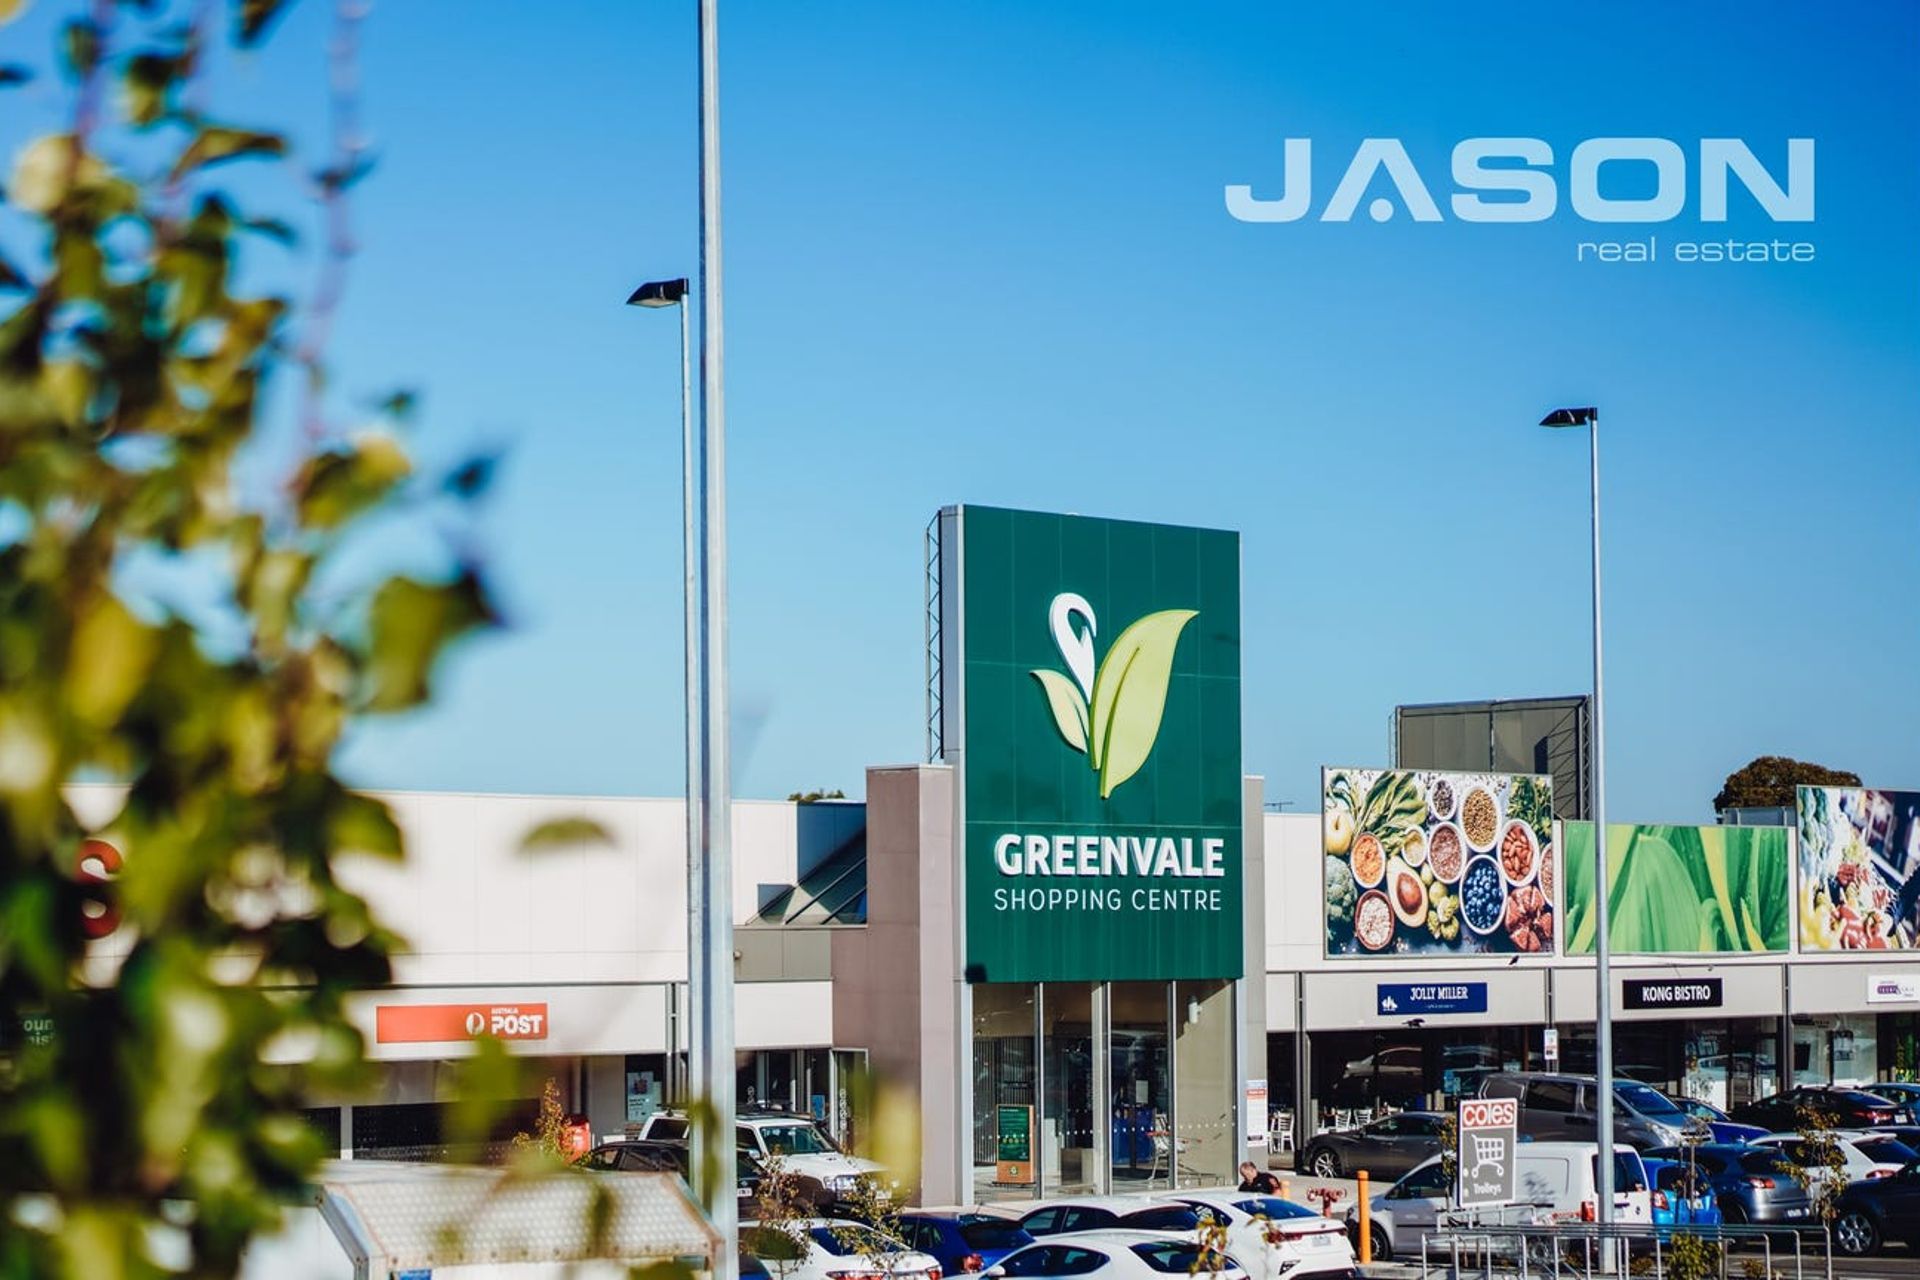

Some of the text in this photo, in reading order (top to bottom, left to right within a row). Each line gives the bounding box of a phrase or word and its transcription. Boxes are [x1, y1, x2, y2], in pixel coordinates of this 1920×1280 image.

[994, 833, 1225, 877] GREENVALE
[994, 888, 1222, 911] SHOPPING CENTRE
[1410, 986, 1468, 1001] JOLLY MILLER
[1642, 985, 1711, 1002] KONG BISTRO
[491, 1014, 543, 1034] POST
[1464, 1103, 1513, 1126] coles
[1473, 1182, 1502, 1196] Trolleys
